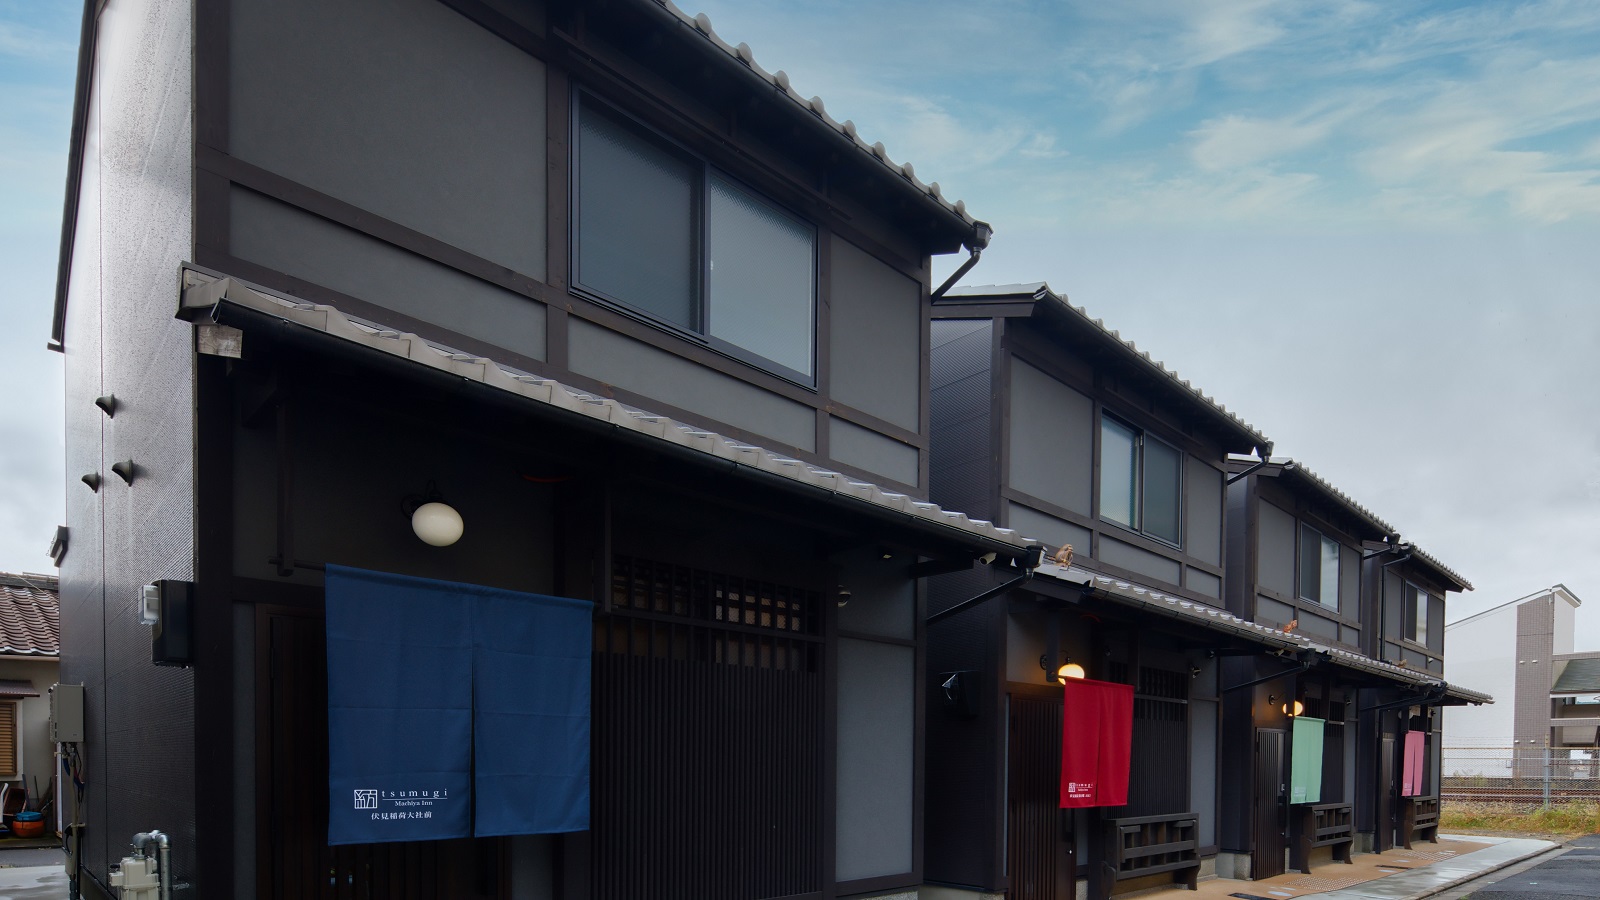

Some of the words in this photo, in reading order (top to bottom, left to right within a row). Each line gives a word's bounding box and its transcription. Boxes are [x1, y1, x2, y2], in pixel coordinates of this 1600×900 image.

[381, 788, 447, 798] tsumugi
[371, 811, 432, 820] 伏見稲荷大社前
